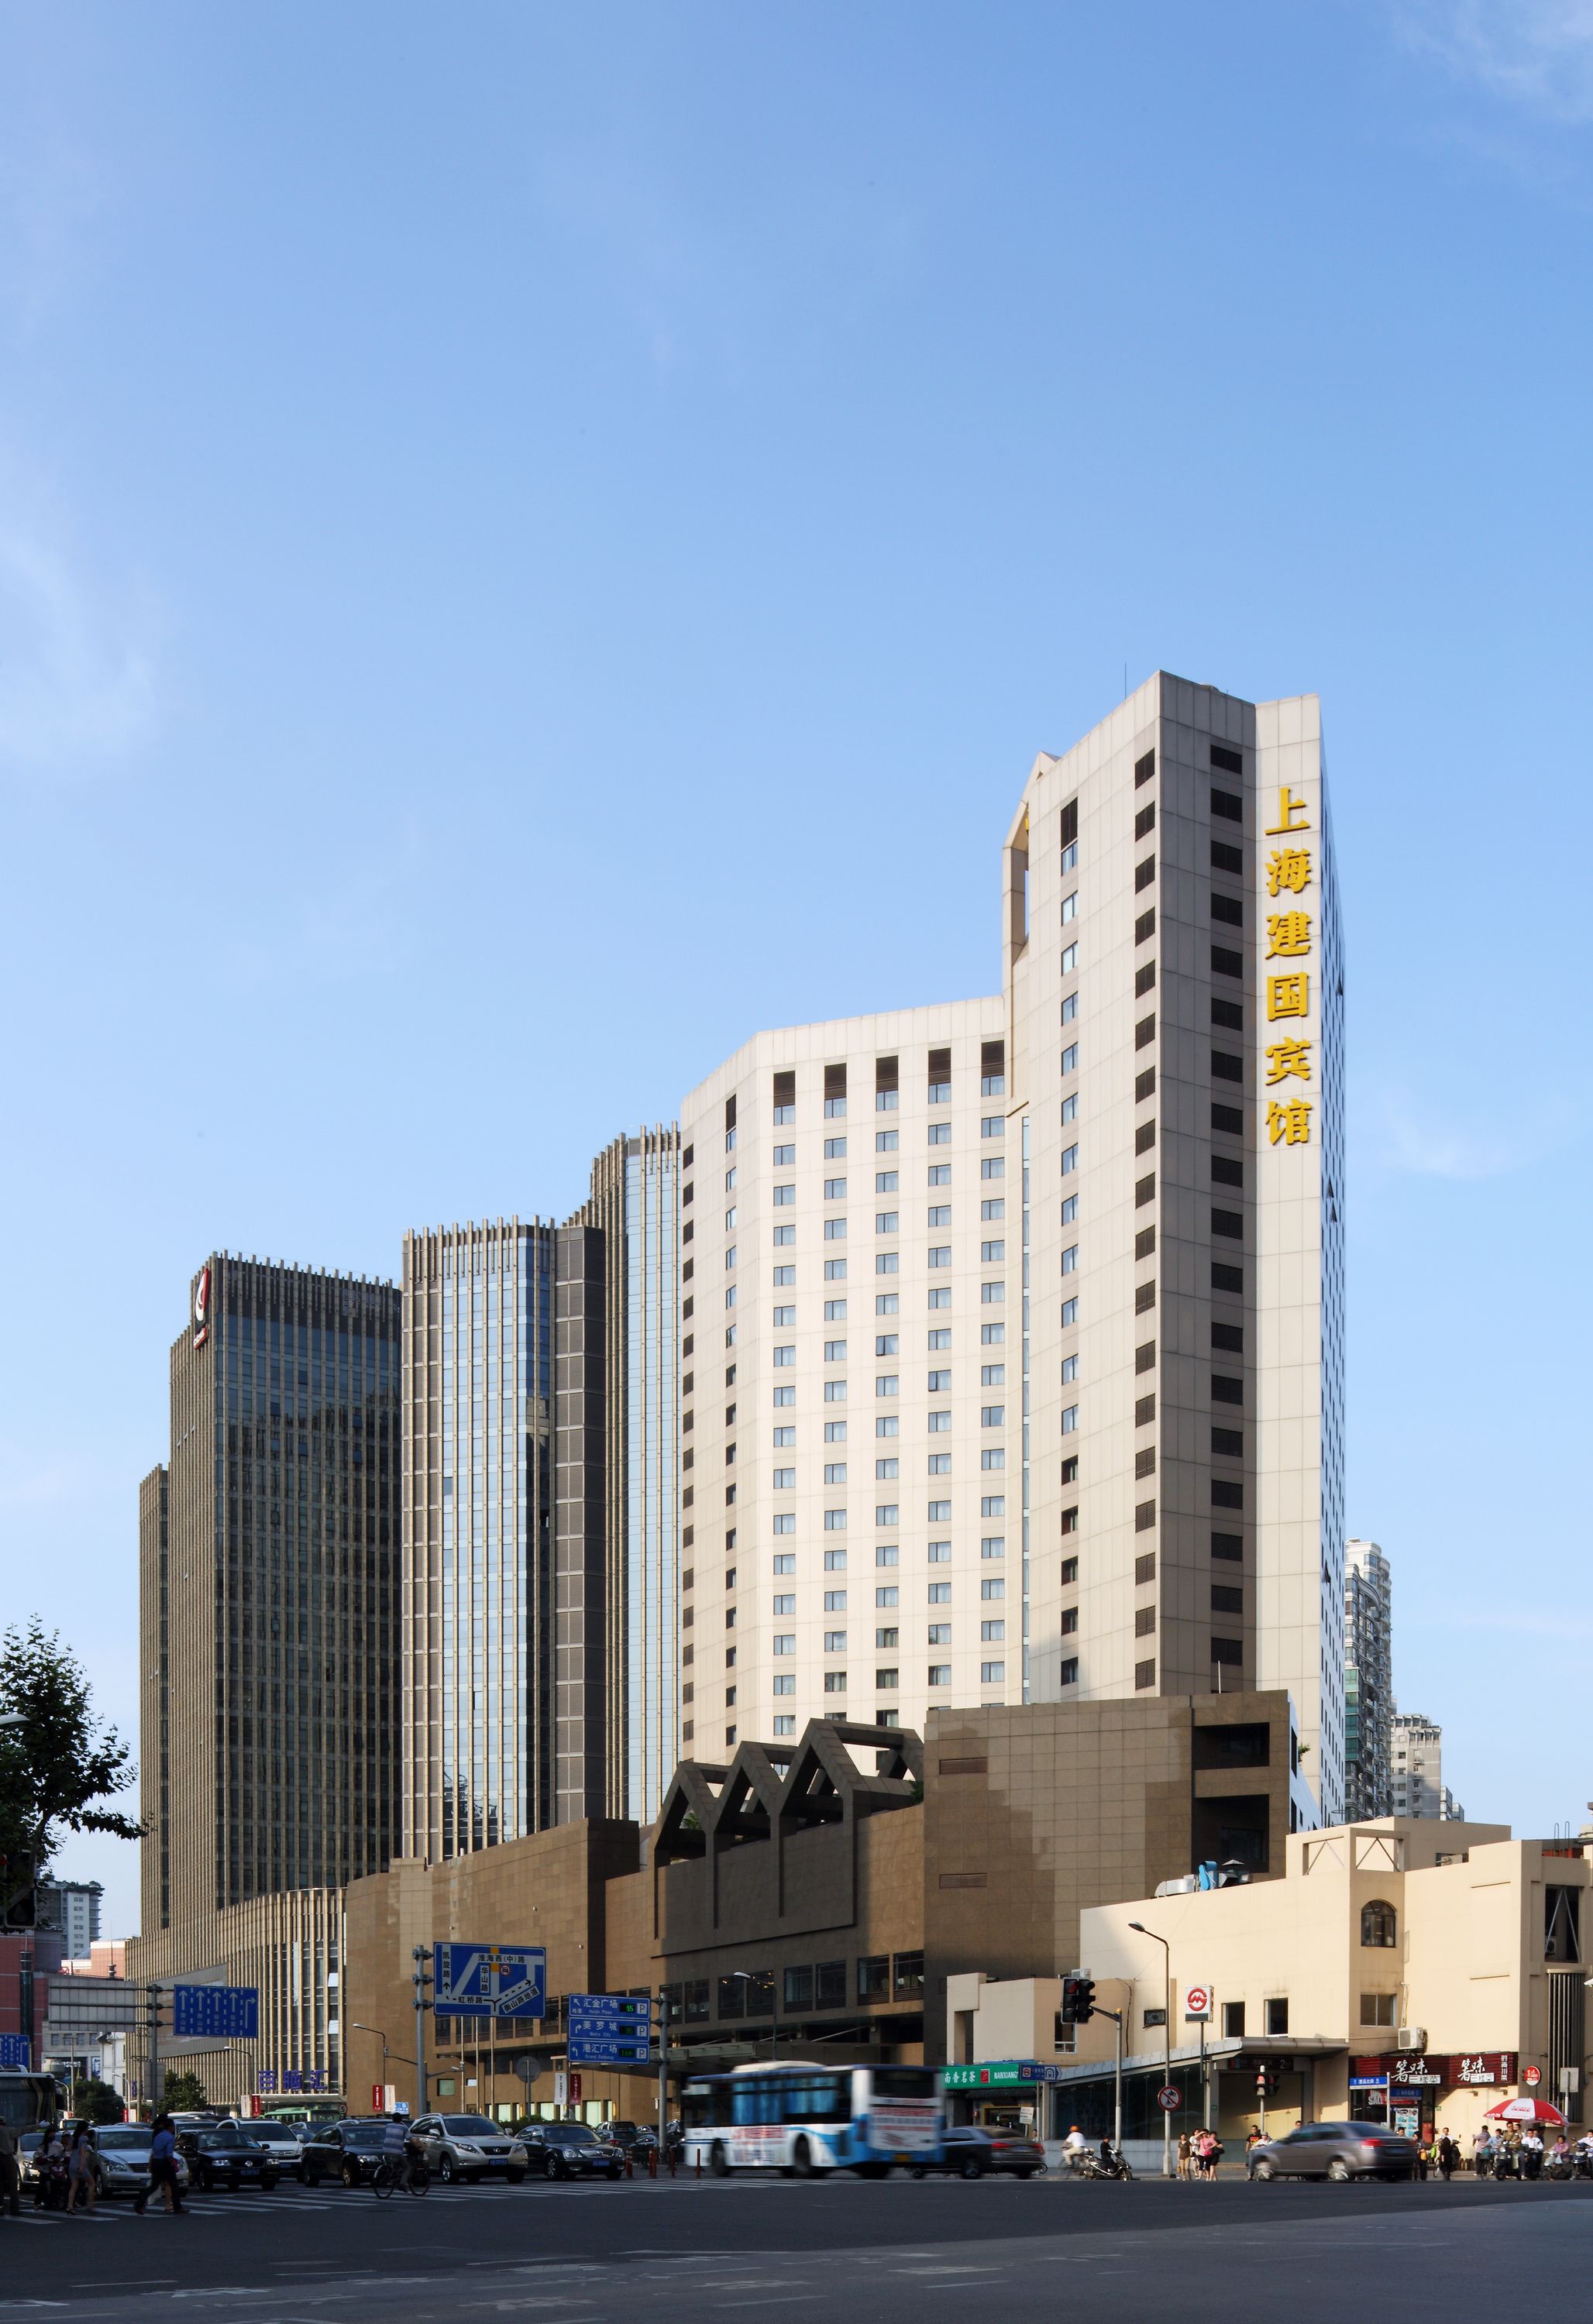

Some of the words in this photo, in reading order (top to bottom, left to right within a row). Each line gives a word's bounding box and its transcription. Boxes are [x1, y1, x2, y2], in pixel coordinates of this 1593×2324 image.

[1264, 786, 1313, 1146] 上海建国宾馆
[583, 1998, 618, 2008] 汇金广场
[583, 2020, 618, 2030] 美罗城
[583, 2044, 618, 2054] 港汇广场
[944, 2070, 976, 2083] 南香茗茶
